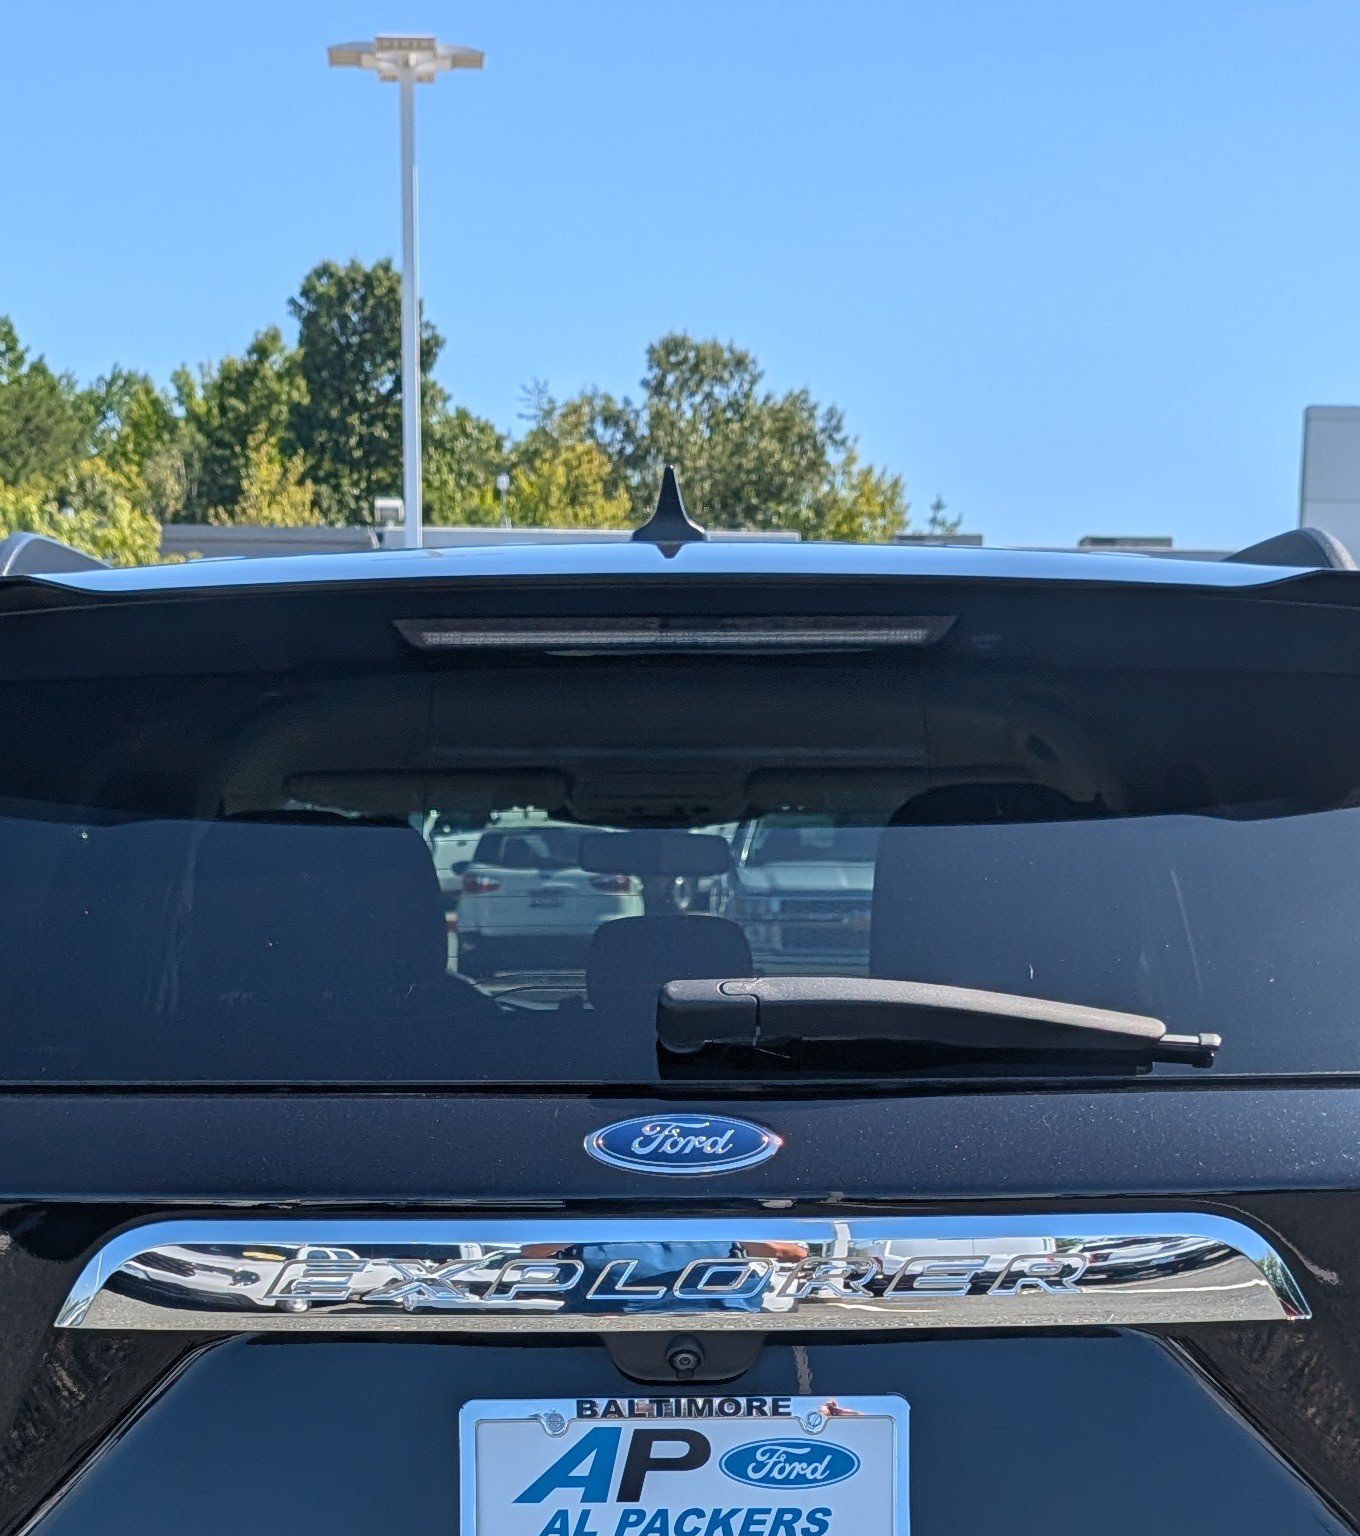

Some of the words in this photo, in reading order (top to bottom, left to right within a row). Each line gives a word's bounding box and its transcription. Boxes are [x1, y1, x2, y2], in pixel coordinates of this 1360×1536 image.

[630, 1120, 736, 1156] Ford
[264, 1253, 1092, 1300] EXPLORER
[576, 1397, 792, 1419] BALTIMORE
[511, 1426, 712, 1504] AP
[746, 1446, 834, 1481] Ford
